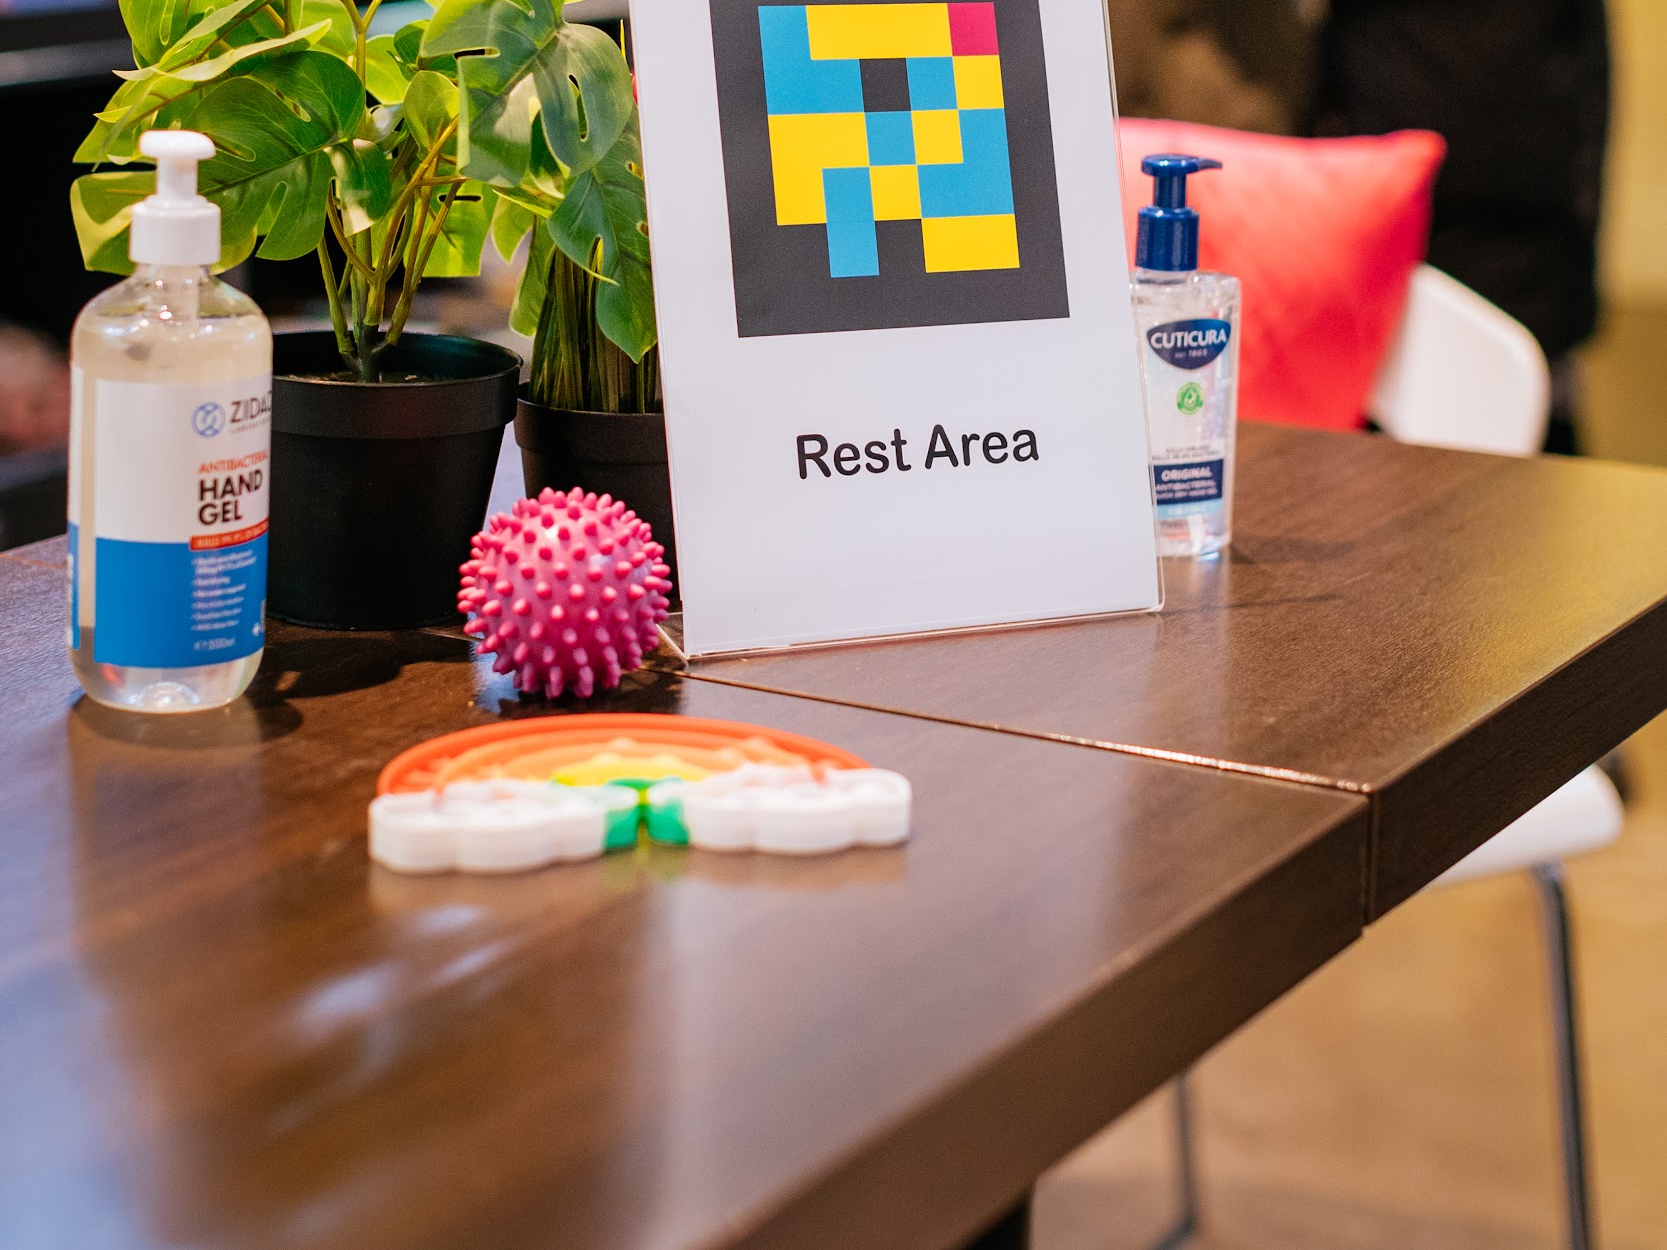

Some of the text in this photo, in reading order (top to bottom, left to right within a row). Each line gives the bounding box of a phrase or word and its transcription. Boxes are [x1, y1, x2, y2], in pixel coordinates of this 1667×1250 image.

[1151, 329, 1227, 349] CUTICURA
[796, 424, 1039, 480] Rest Area
[199, 468, 264, 503] HAND
[1161, 467, 1212, 482] ORIGINAL
[199, 499, 244, 526] GEL
